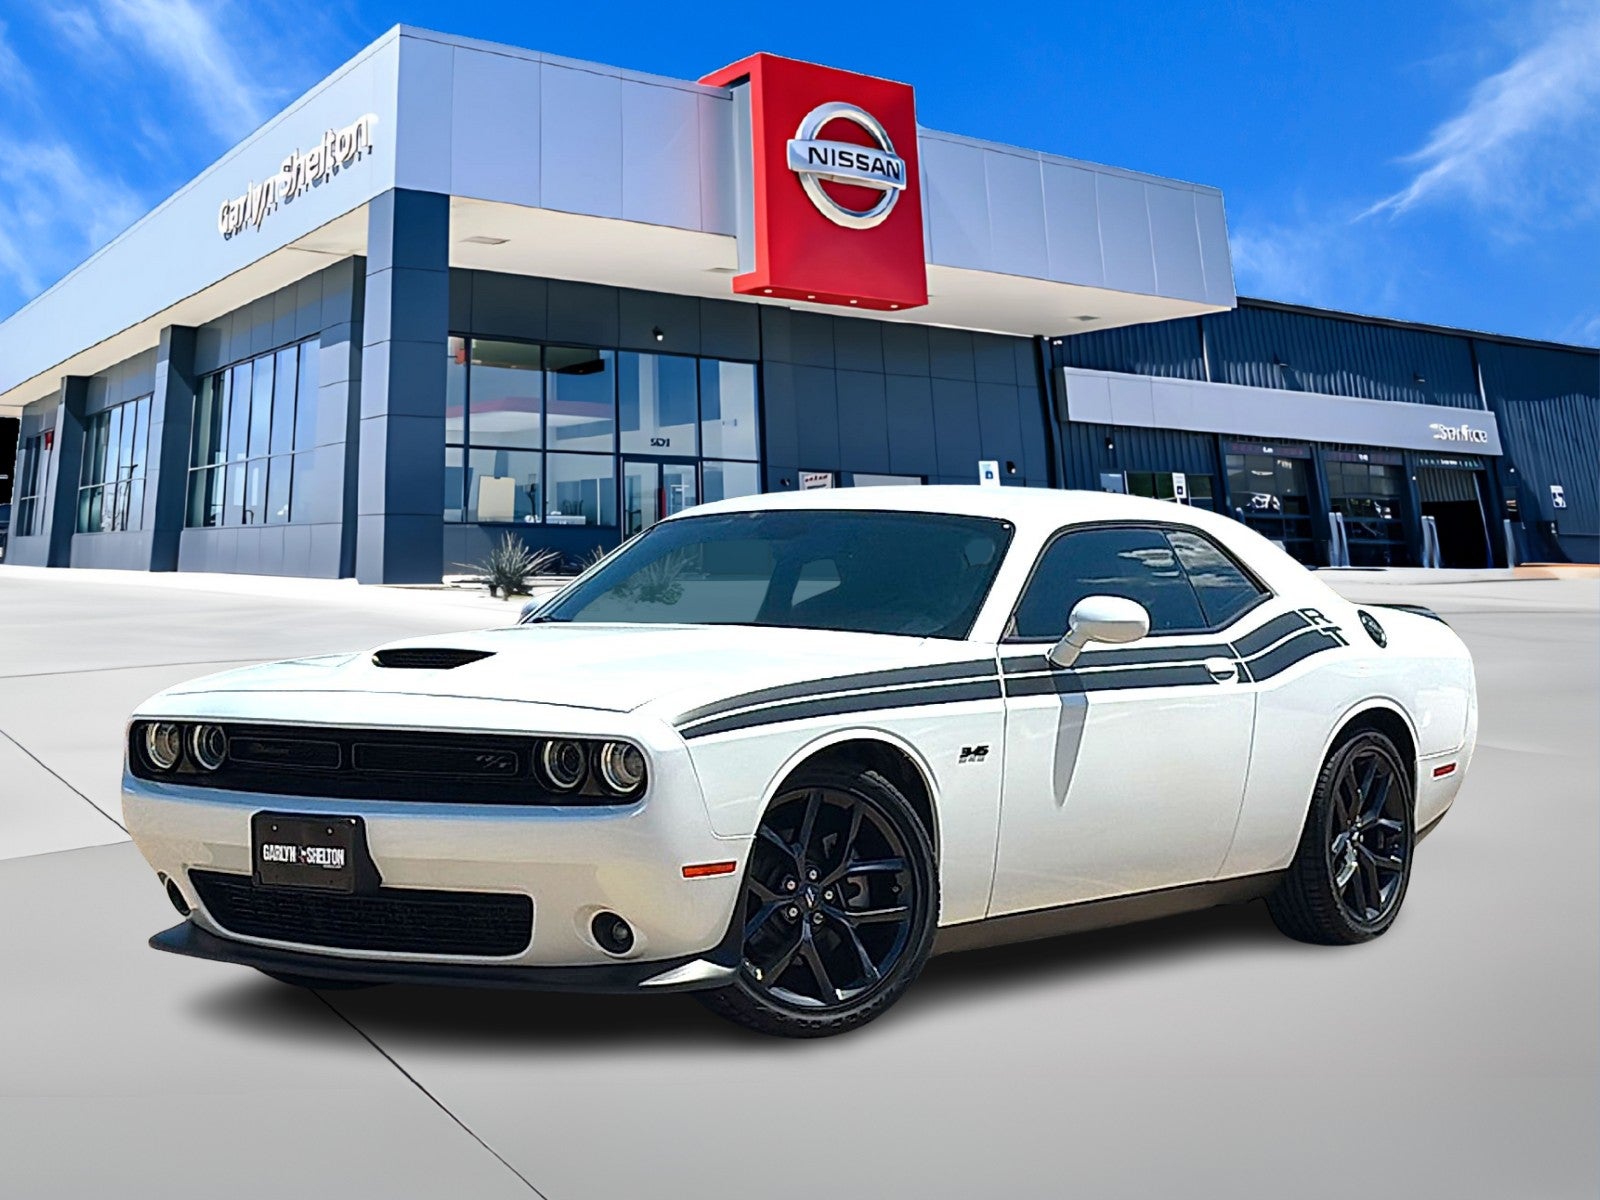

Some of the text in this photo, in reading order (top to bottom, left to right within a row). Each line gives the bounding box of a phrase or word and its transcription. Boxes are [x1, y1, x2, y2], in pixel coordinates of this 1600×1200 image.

[279, 114, 374, 199] Shelton
[808, 146, 901, 181] NISSAN
[1429, 422, 1489, 443] Service
[306, 847, 345, 866] SHELTON
